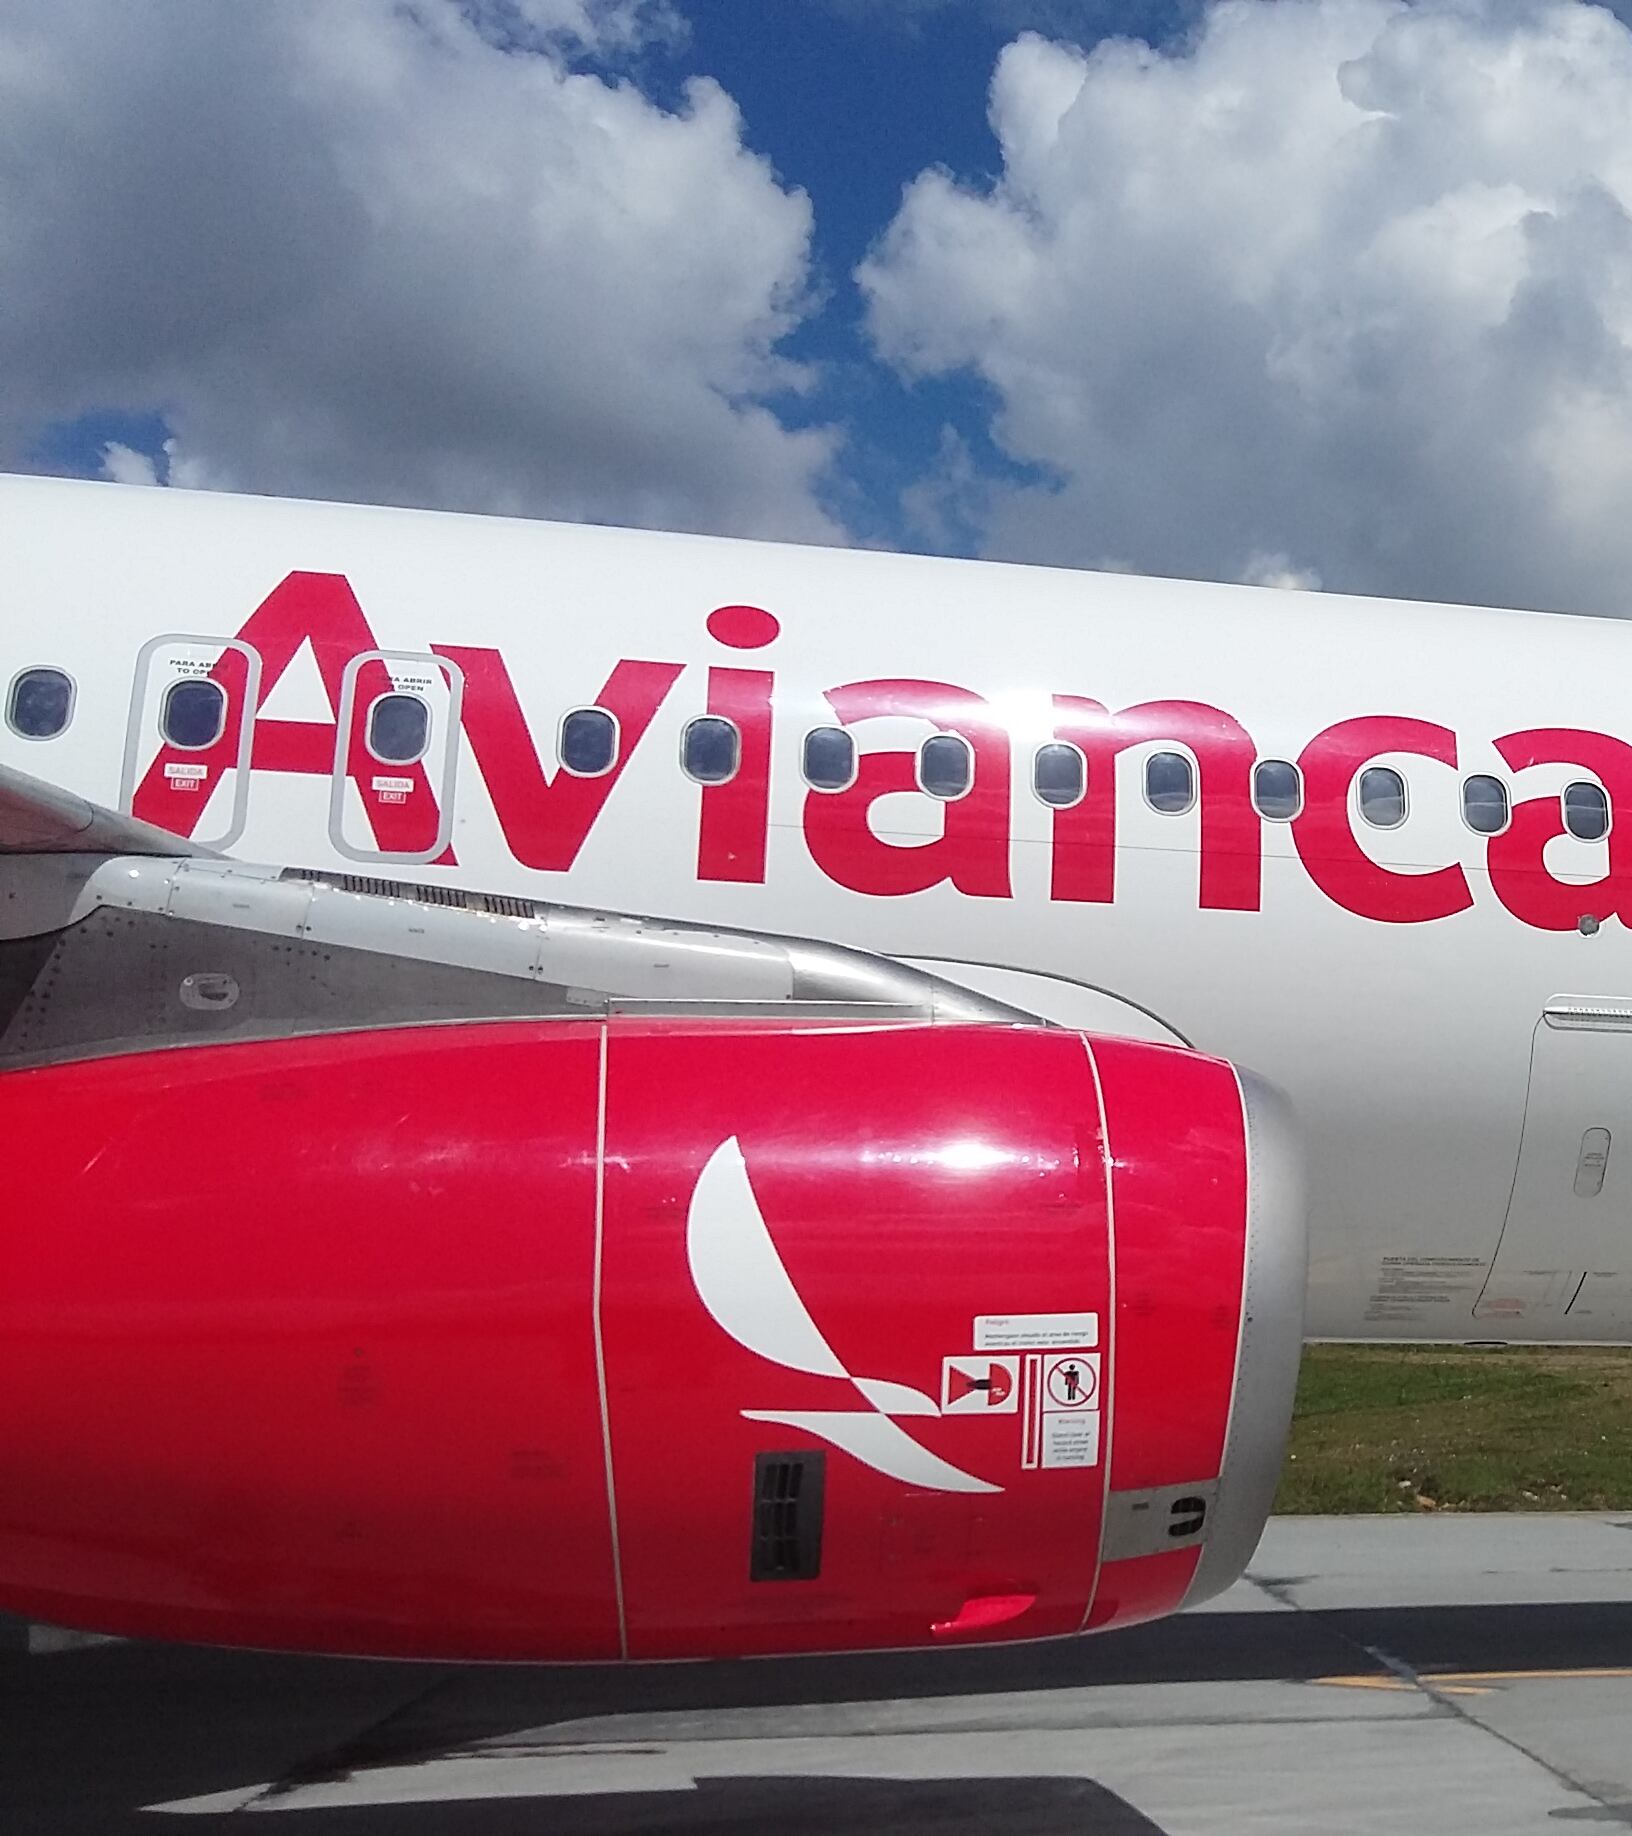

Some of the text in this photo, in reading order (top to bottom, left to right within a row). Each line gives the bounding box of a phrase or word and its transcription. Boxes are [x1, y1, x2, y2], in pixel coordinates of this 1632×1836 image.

[169, 659, 195, 668] PARA
[177, 667, 190, 675] TO
[403, 677, 432, 685] ABRIR
[398, 684, 424, 692] OPEN
[168, 765, 204, 776] SALIDA
[174, 779, 196, 788] EXIT
[377, 779, 410, 789] SALIDA
[383, 792, 403, 801] EXIT
